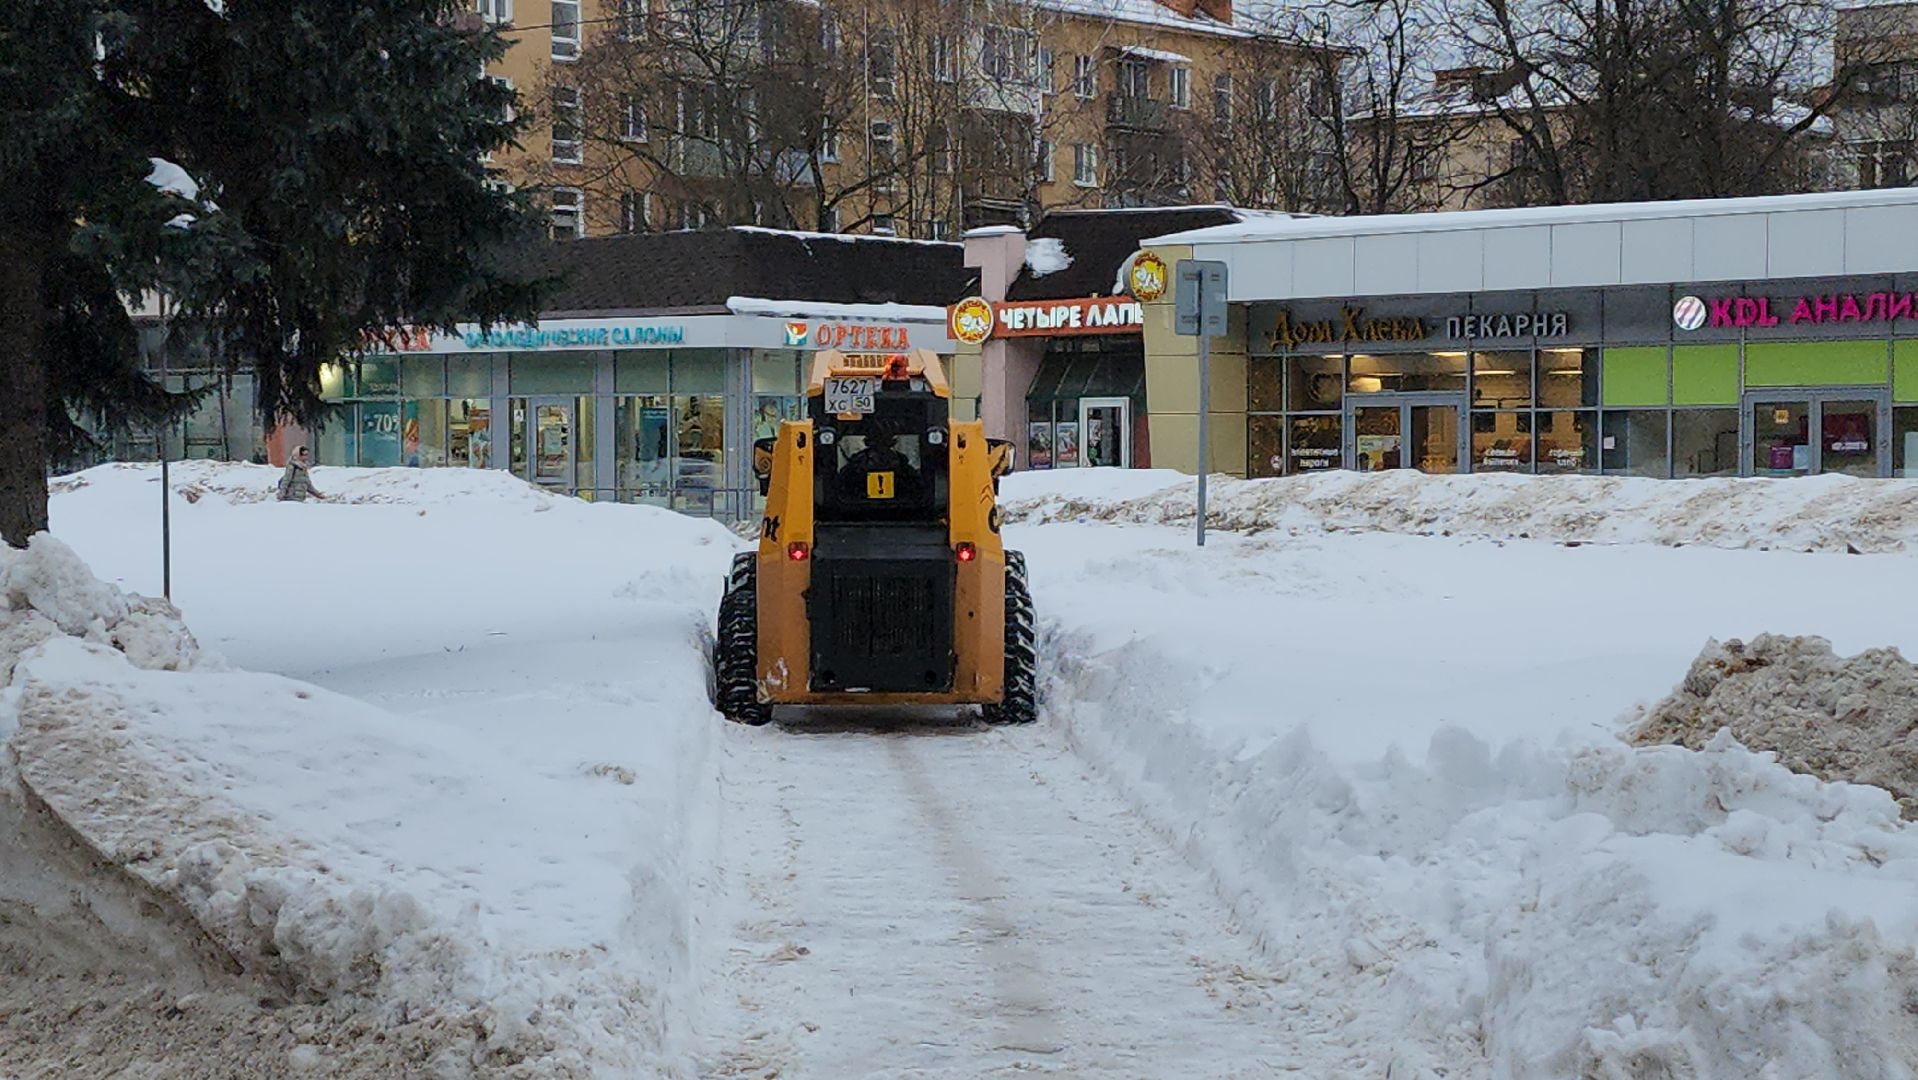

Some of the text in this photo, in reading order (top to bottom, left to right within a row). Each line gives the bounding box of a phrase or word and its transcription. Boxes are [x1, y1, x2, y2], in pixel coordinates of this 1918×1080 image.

[1000, 306, 1082, 330] ЧЕТЫРЕ
[1711, 290, 1918, 327] KDL АНАЛИ
[611, 325, 684, 346] САЛОНЫ
[815, 324, 910, 349] ОРТЕКА
[1446, 312, 1571, 340] ПЕКАРНЯ
[831, 379, 867, 394] 7627
